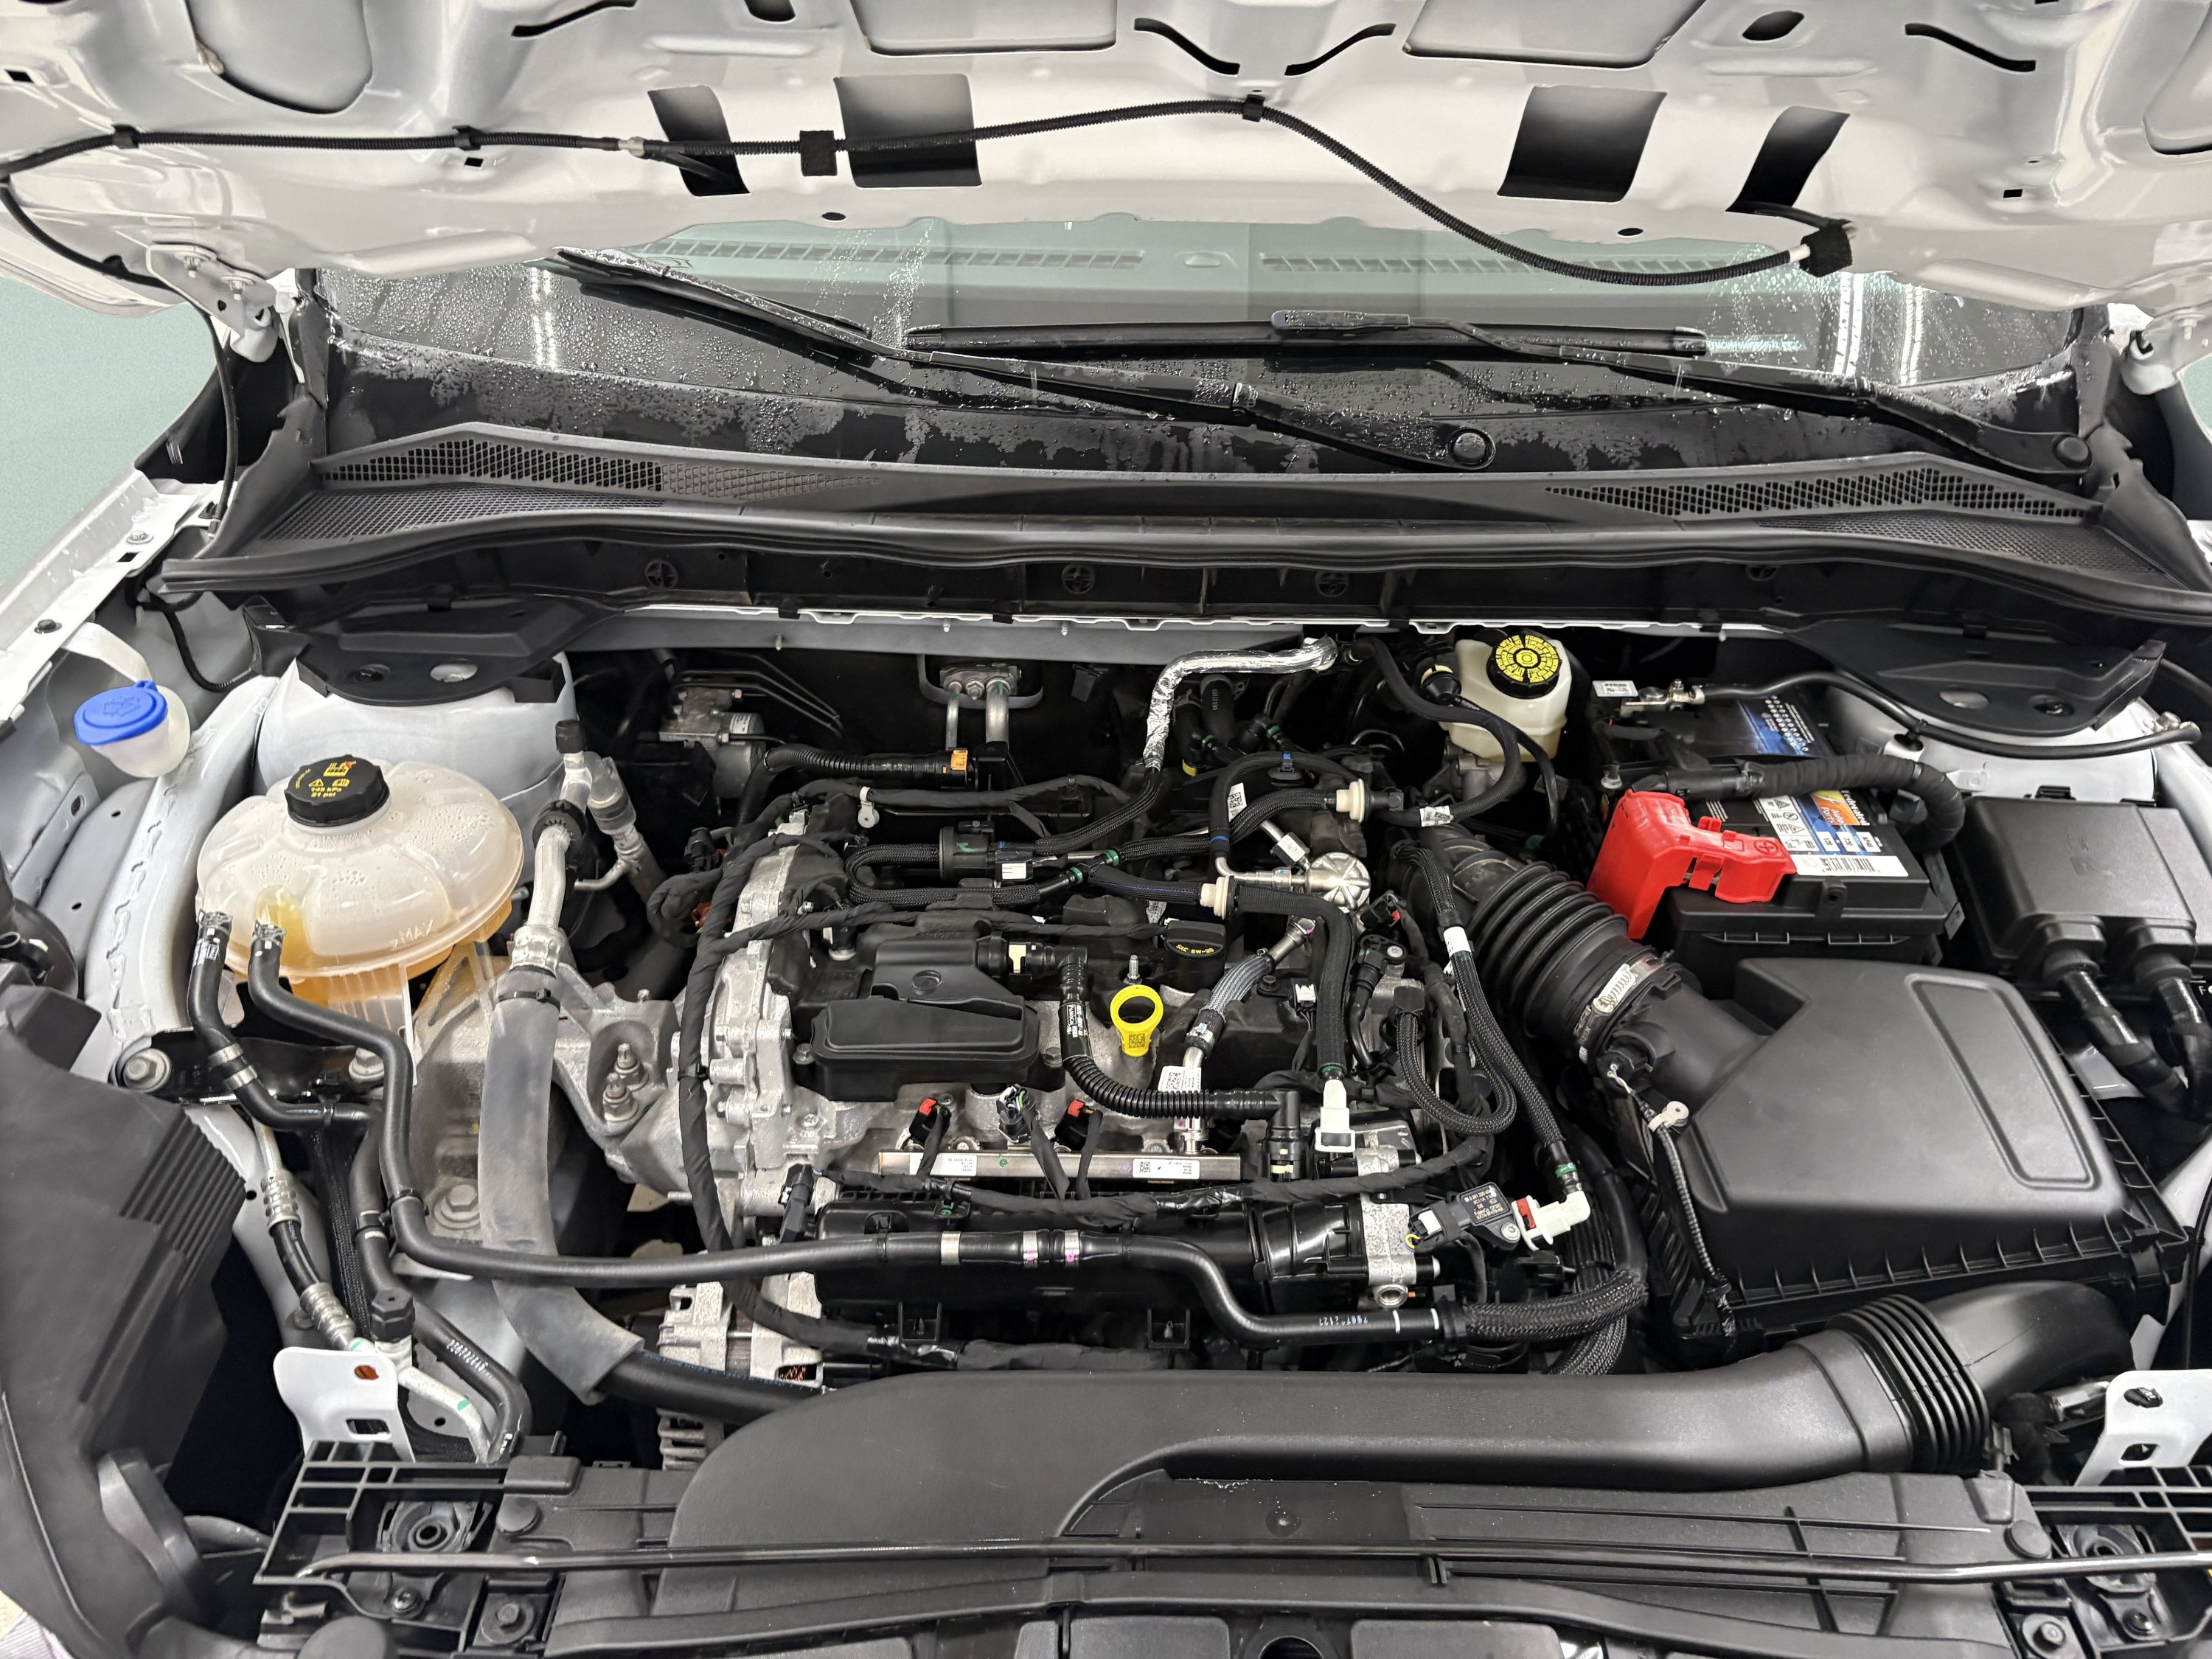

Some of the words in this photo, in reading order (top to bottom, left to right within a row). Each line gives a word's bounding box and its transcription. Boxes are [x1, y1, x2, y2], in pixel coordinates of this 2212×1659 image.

[1820, 807, 1834, 824] Parts
[1830, 809, 1845, 824] Auto
[1175, 944, 1189, 953] SAE
